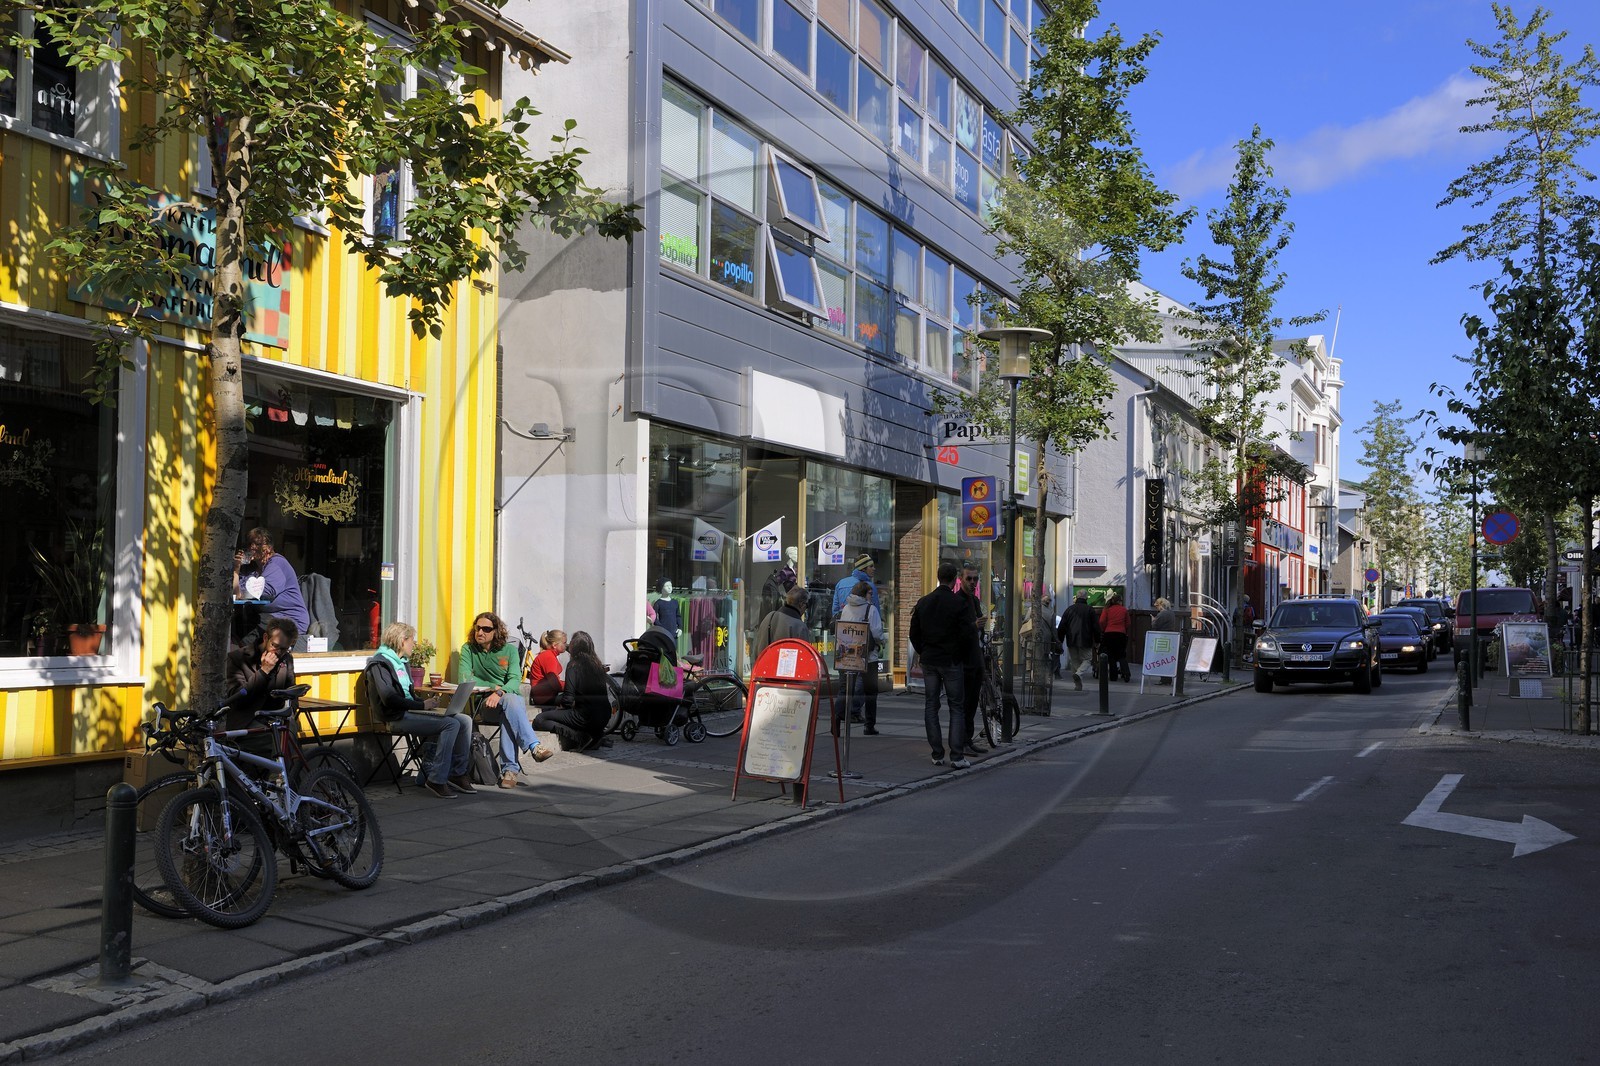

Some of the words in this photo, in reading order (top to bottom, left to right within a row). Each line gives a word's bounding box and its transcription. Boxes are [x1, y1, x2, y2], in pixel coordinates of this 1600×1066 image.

[982, 120, 1001, 160] ásta
[724, 261, 754, 284] papilla
[936, 445, 959, 467] 25
[1145, 655, 1177, 671] ÚTSALA
